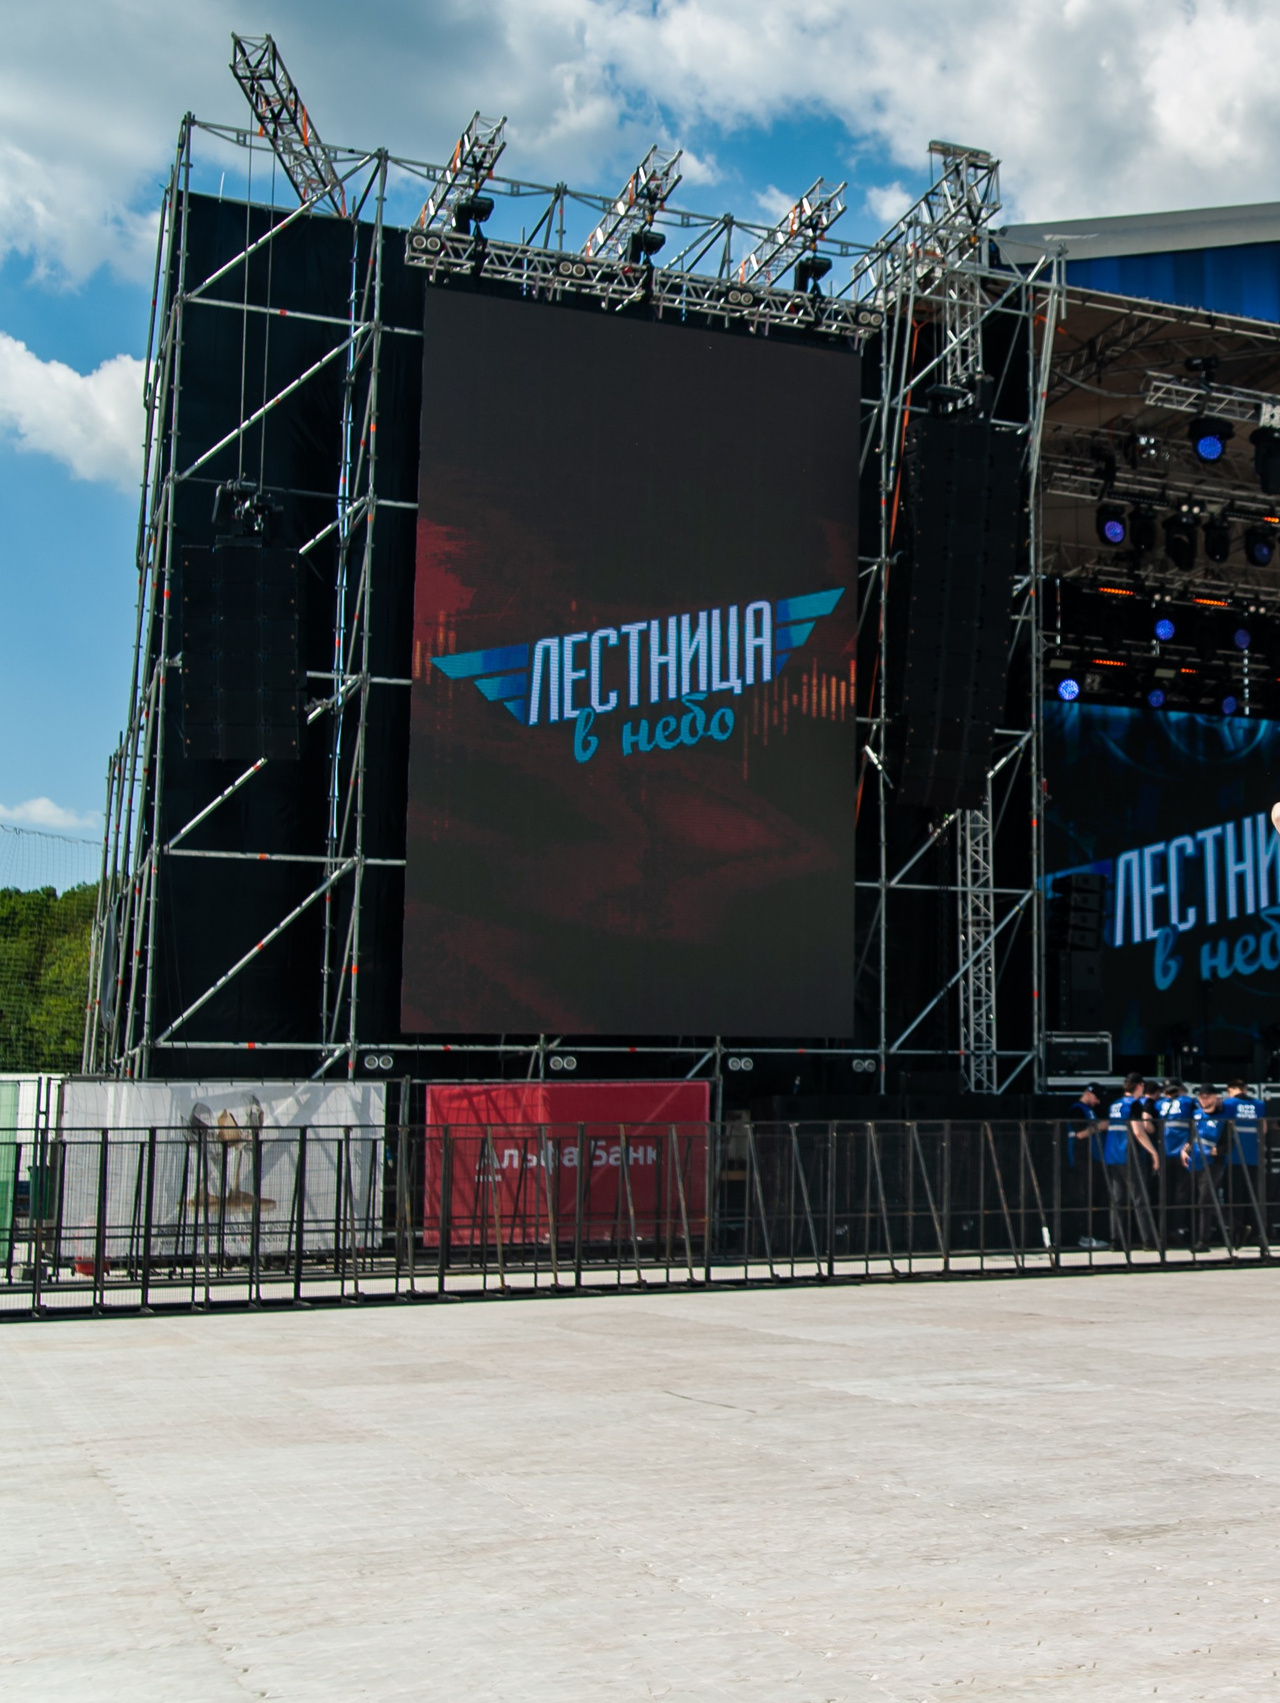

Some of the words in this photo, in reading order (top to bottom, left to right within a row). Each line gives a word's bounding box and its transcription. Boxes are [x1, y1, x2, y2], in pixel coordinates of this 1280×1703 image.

[529, 600, 772, 726] ЛЕСТНИЦА
[574, 708, 599, 763] в
[623, 693, 735, 756] небо
[1153, 924, 1178, 990] в
